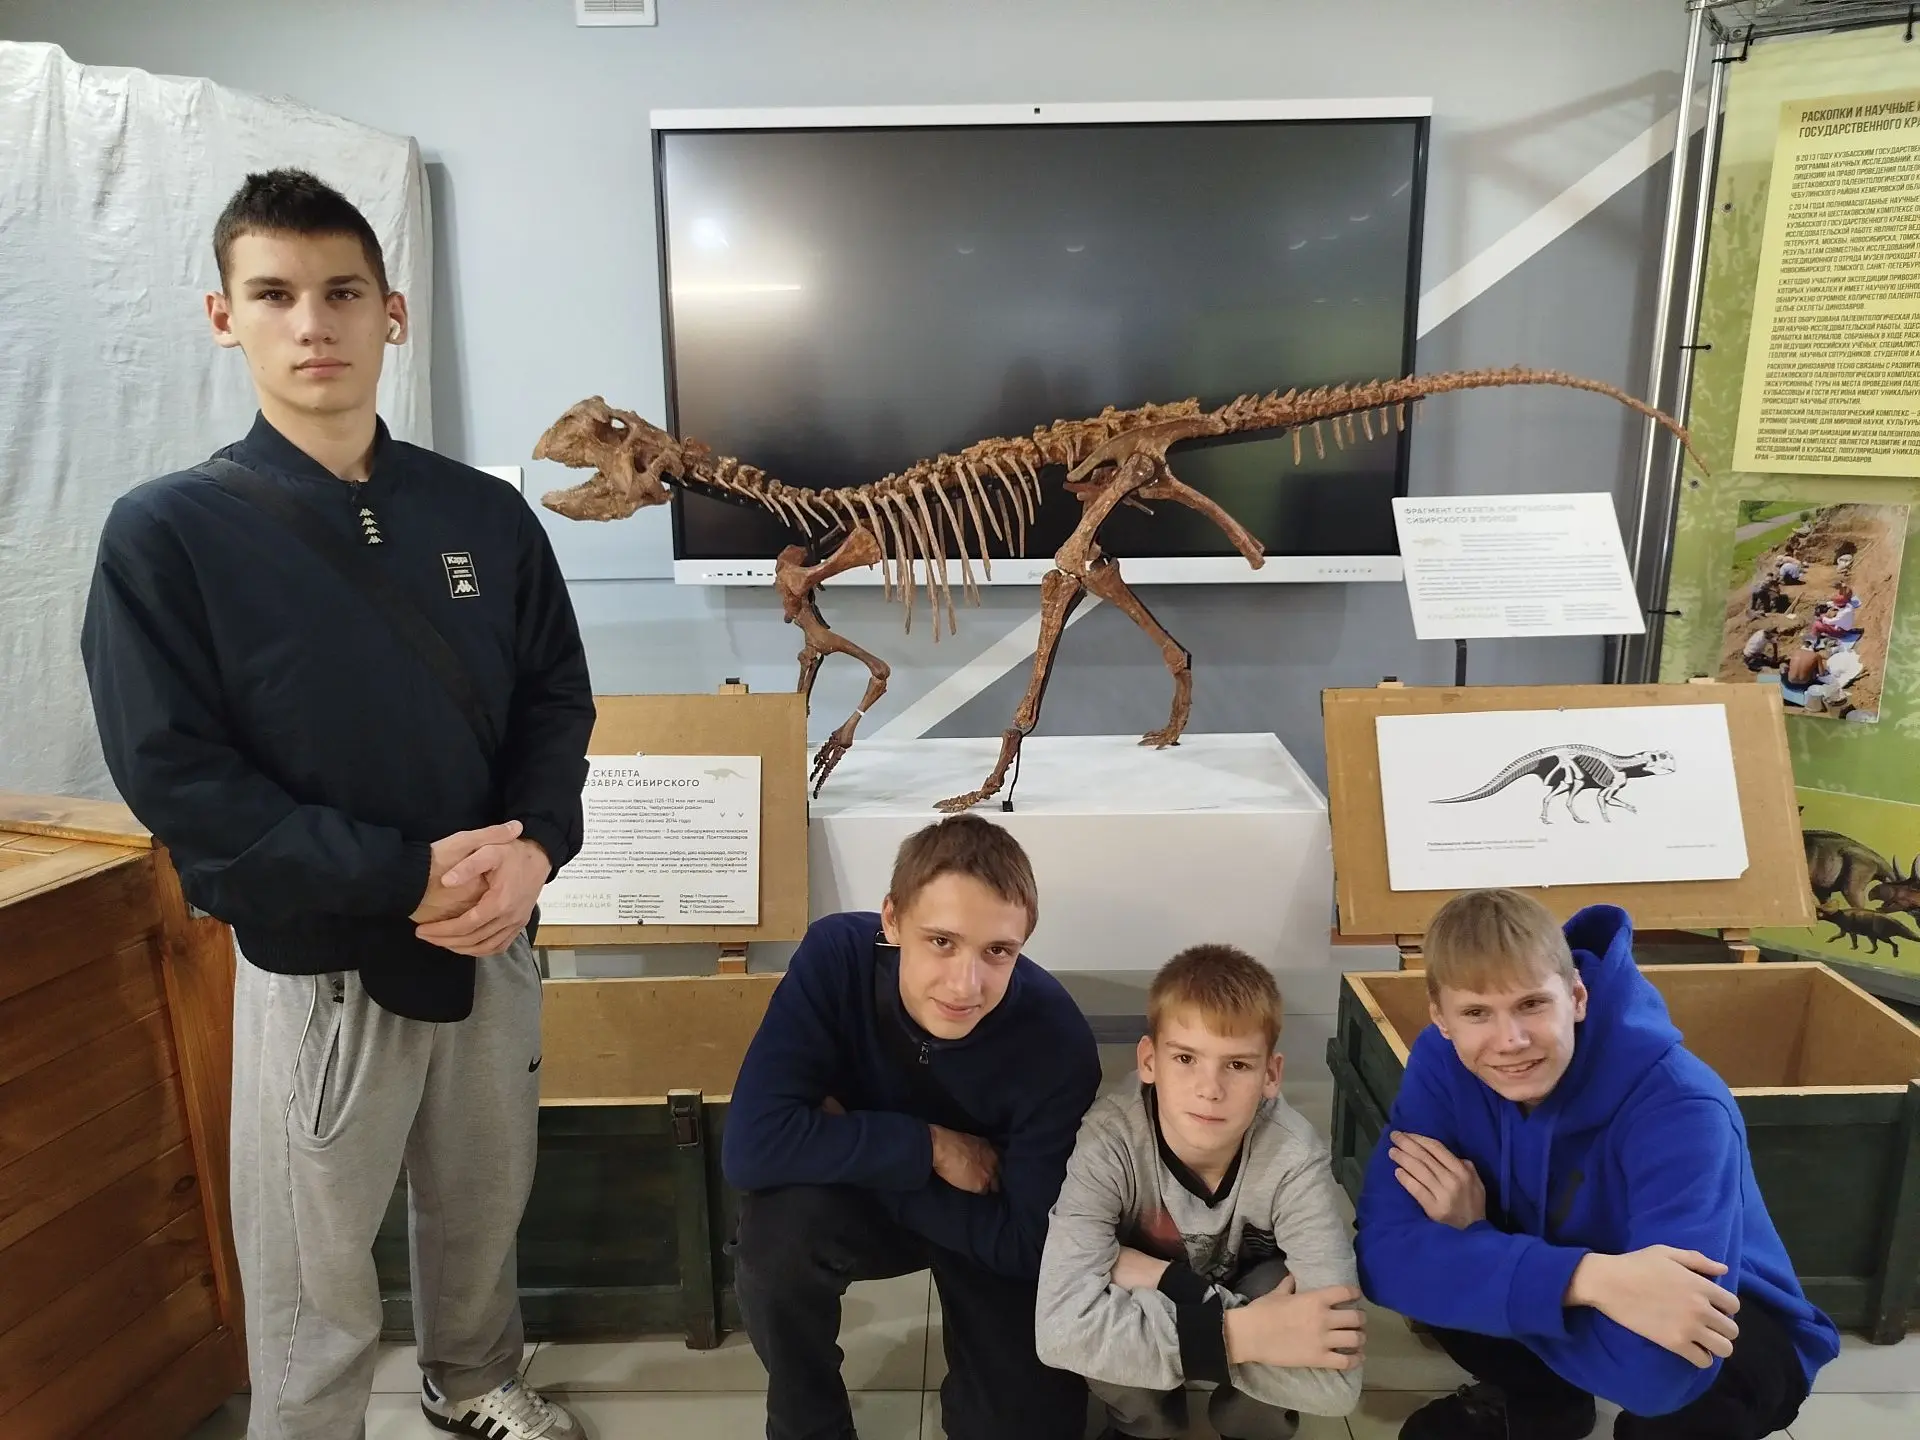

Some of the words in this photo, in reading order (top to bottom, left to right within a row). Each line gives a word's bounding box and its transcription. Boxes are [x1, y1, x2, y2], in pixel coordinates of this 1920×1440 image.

[1801, 107, 1853, 122] РАСКОПКИ
[1855, 107, 1862, 117] И
[1865, 101, 1915, 117] НАУЧНЫЕ
[1799, 118, 1901, 138] ГОСУДАРСТВЕННОГО
[1407, 516, 1468, 524] СИБИРСКОГО
[447, 556, 468, 565] Kappa
